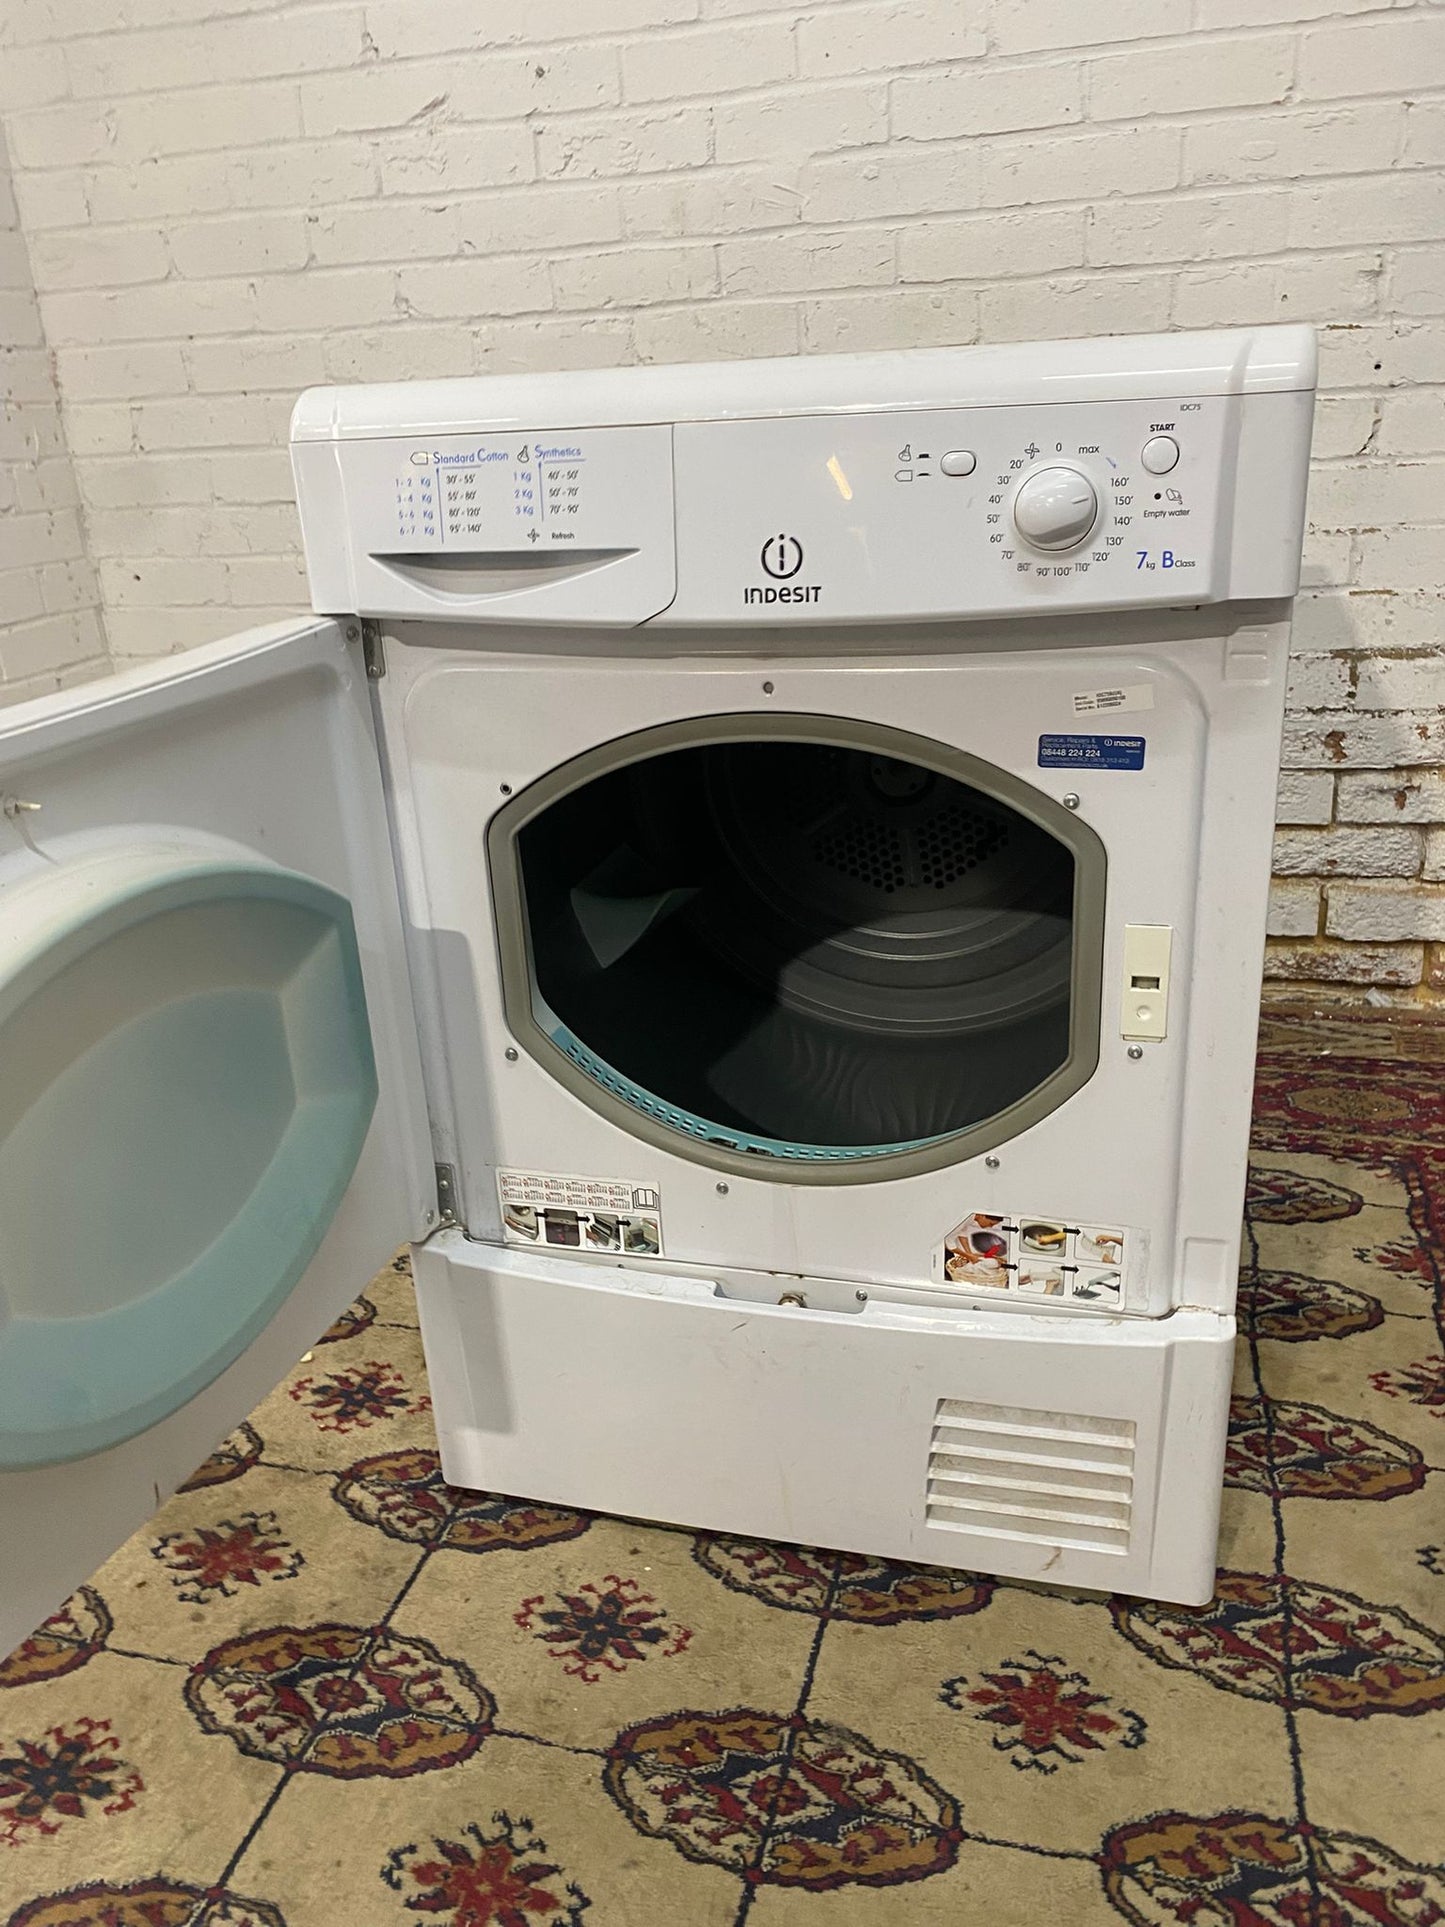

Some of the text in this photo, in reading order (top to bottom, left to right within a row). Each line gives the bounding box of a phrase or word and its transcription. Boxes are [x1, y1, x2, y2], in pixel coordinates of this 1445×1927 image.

[1180, 404, 1201, 412] IDC75
[1150, 423, 1176, 432] START
[534, 445, 582, 460] Synthetics
[1055, 442, 1063, 452] 0
[1078, 445, 1100, 454] max
[433, 448, 509, 464] Standard Cotton
[420, 476, 431, 488] Kg
[521, 471, 532, 483] Kg
[422, 493, 432, 504] Kg
[522, 488, 533, 499] Kg
[423, 510, 434, 520] Kg
[523, 505, 534, 516] Kg
[1143, 508, 1190, 519] Empty water
[424, 525, 435, 536] Kg
[552, 531, 575, 540] Refresh
[1068, 749, 1083, 757] 224
